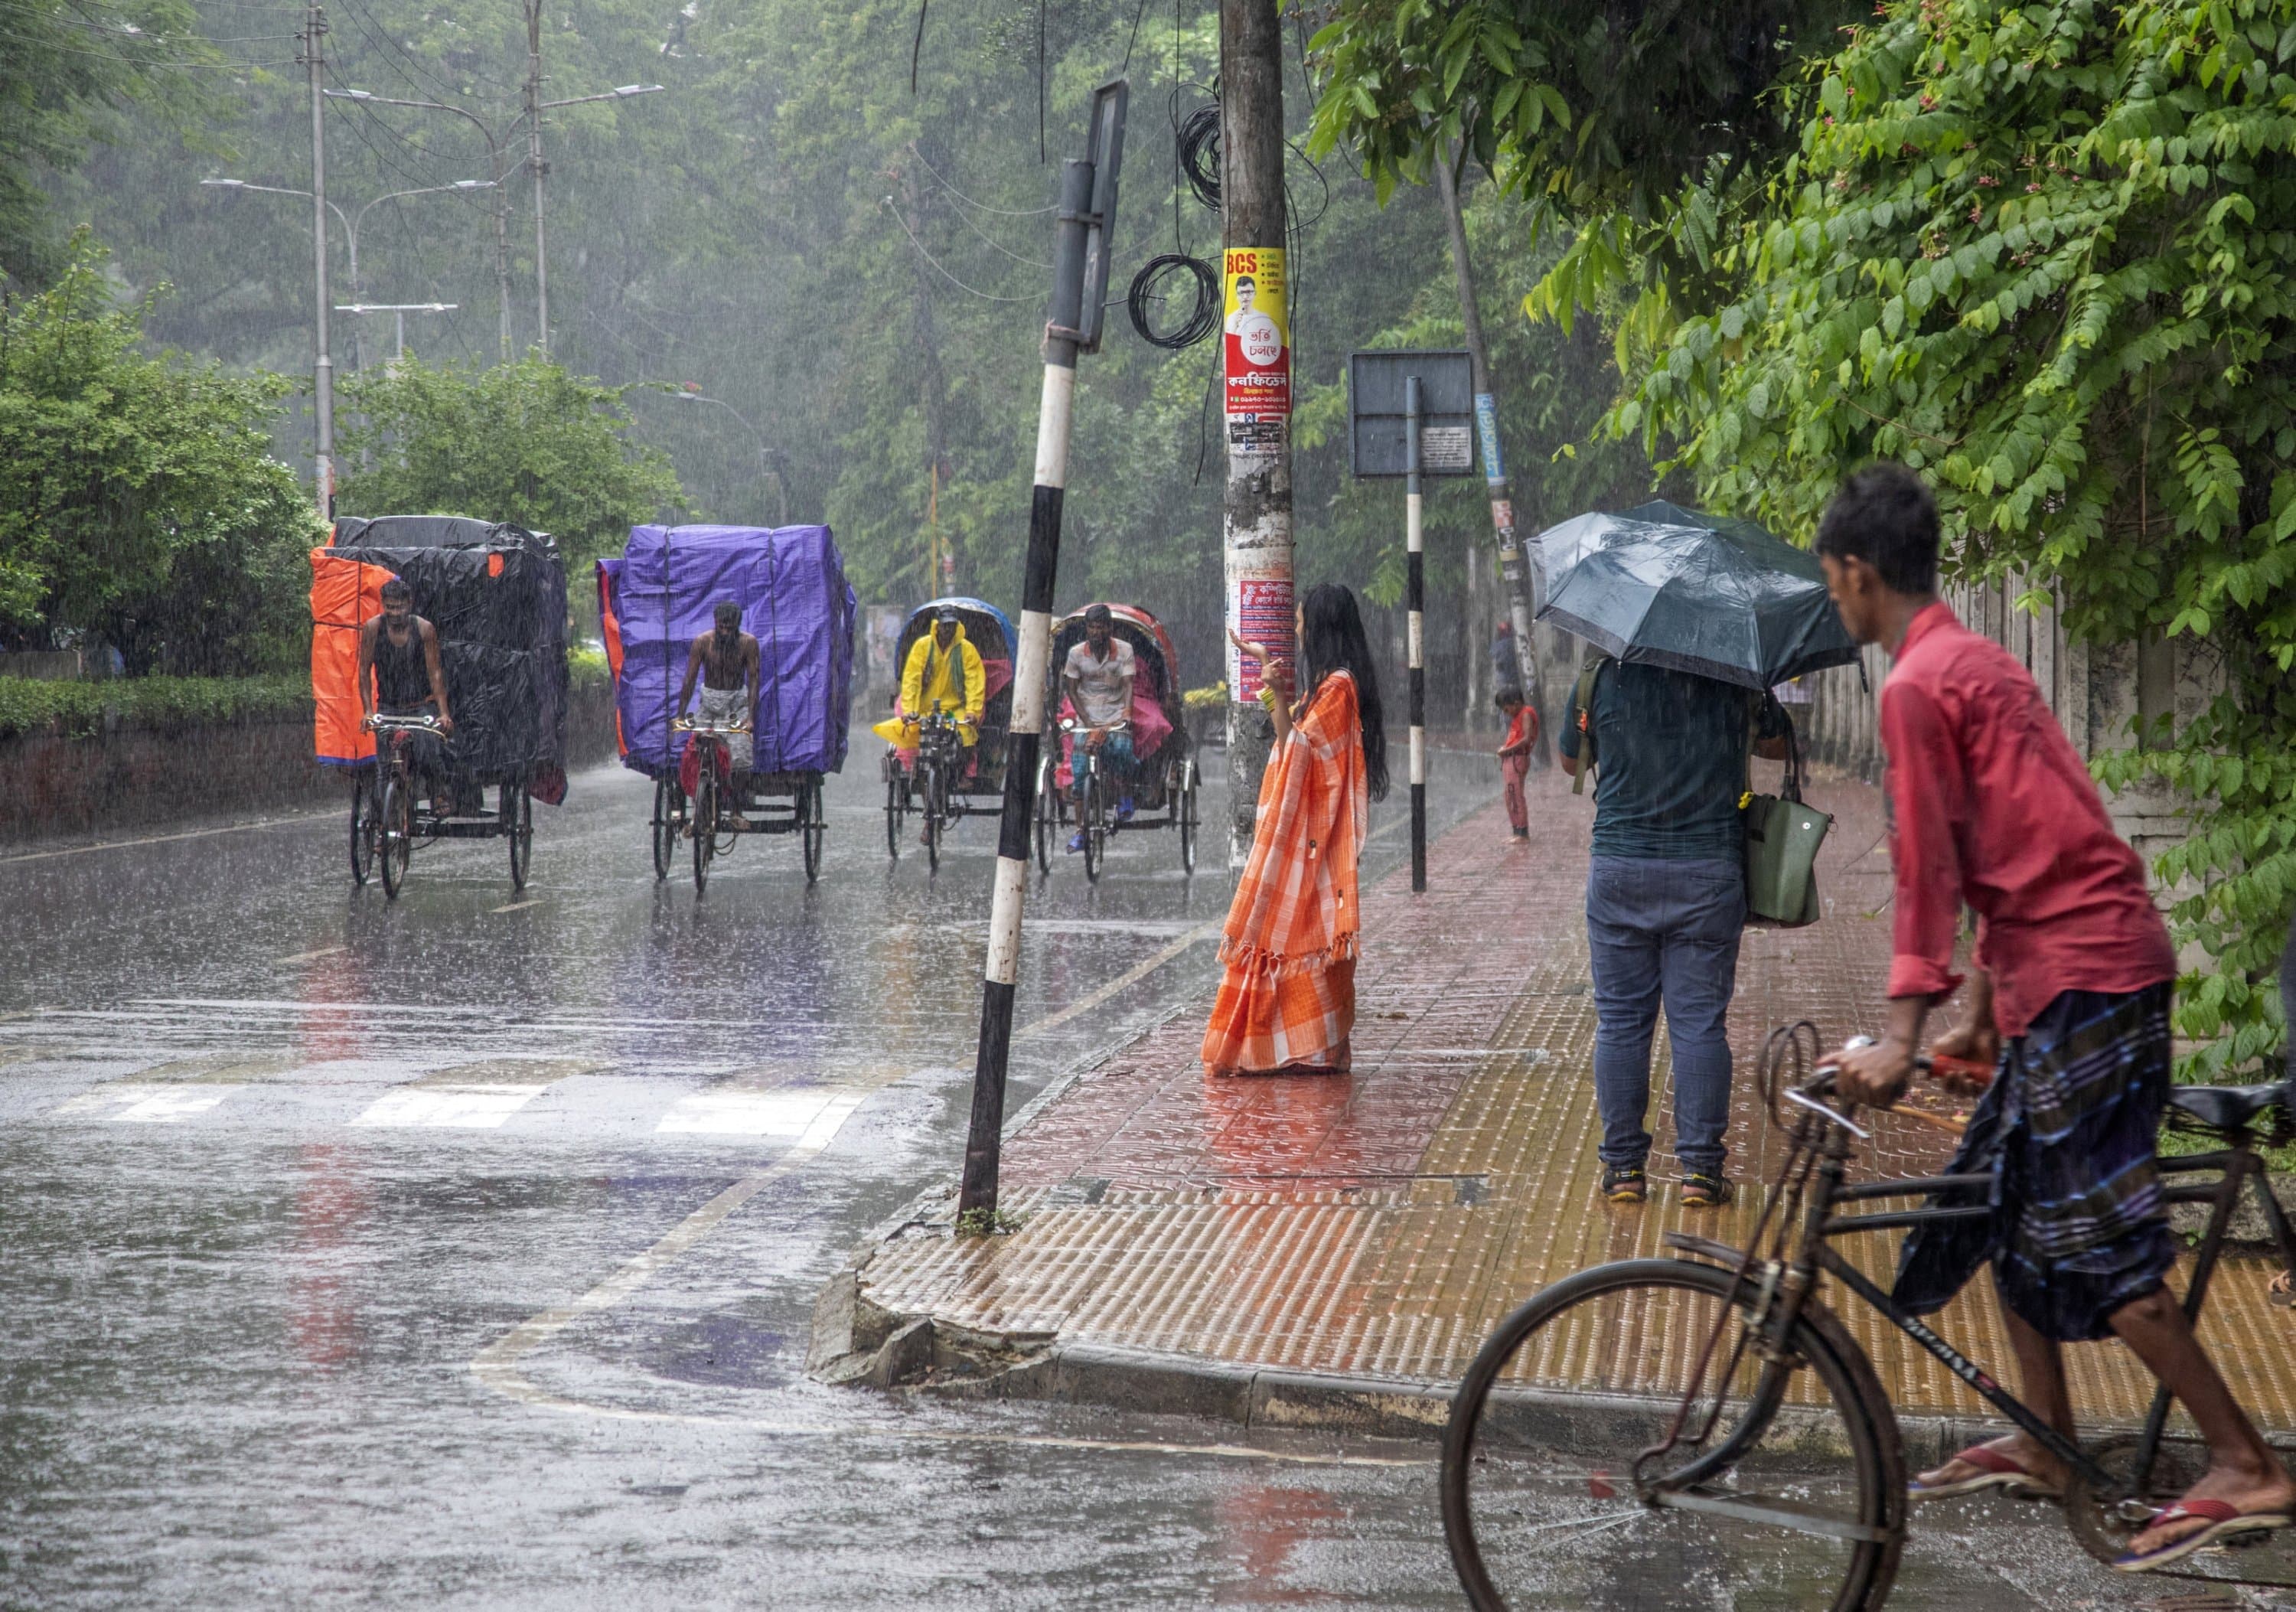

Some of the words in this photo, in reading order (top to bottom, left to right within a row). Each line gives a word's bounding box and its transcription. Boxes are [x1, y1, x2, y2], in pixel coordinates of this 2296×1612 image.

[1227, 253, 1257, 274] BCS
[1248, 328, 1271, 342] ভর্তি
[1249, 345, 1277, 357] চলছে
